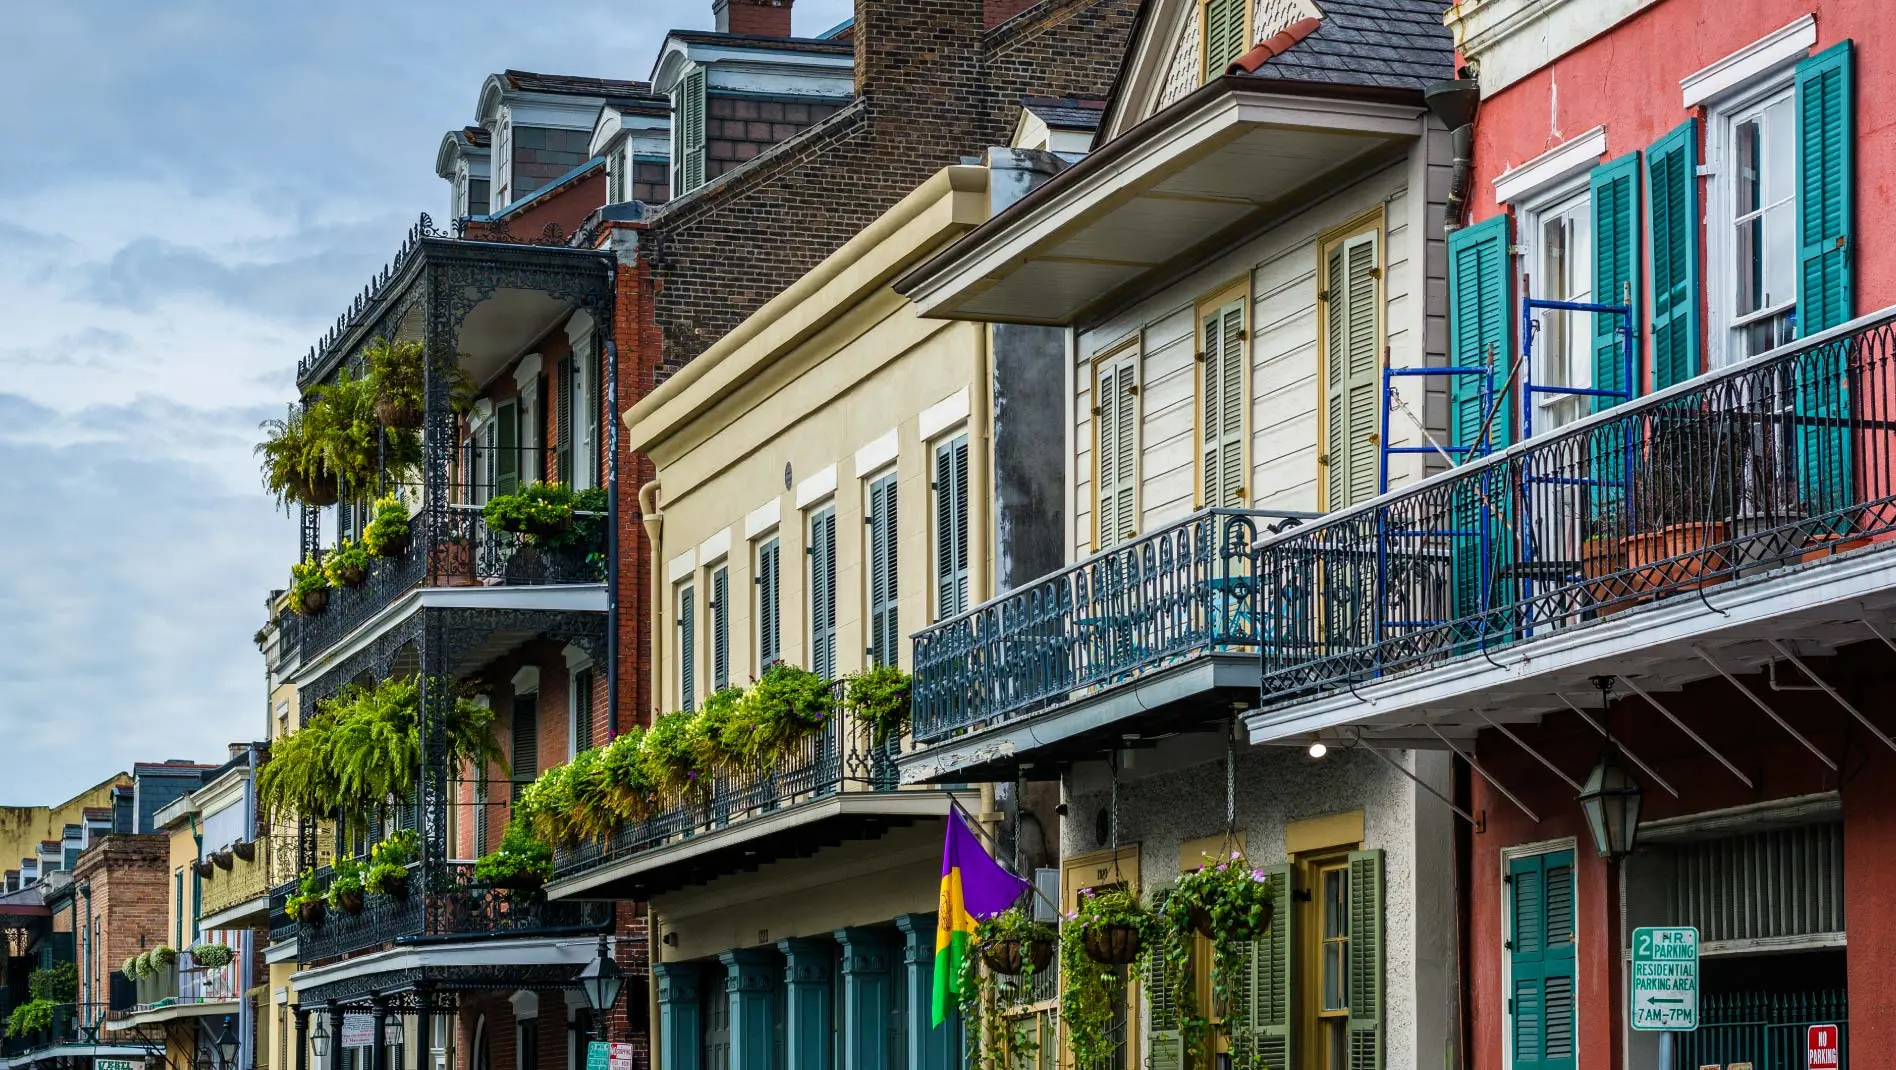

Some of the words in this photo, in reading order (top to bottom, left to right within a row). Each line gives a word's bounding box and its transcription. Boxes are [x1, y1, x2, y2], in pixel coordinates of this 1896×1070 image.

[1639, 935, 1651, 956] 2
[1654, 944, 1694, 958] PARKING
[1636, 964, 1693, 976] RESIDENTIAL
[1636, 978, 1671, 991] PARKING
[1672, 978, 1695, 990] AREA
[1818, 1031, 1827, 1047] NO
[1810, 1048, 1837, 1064] PARKING
